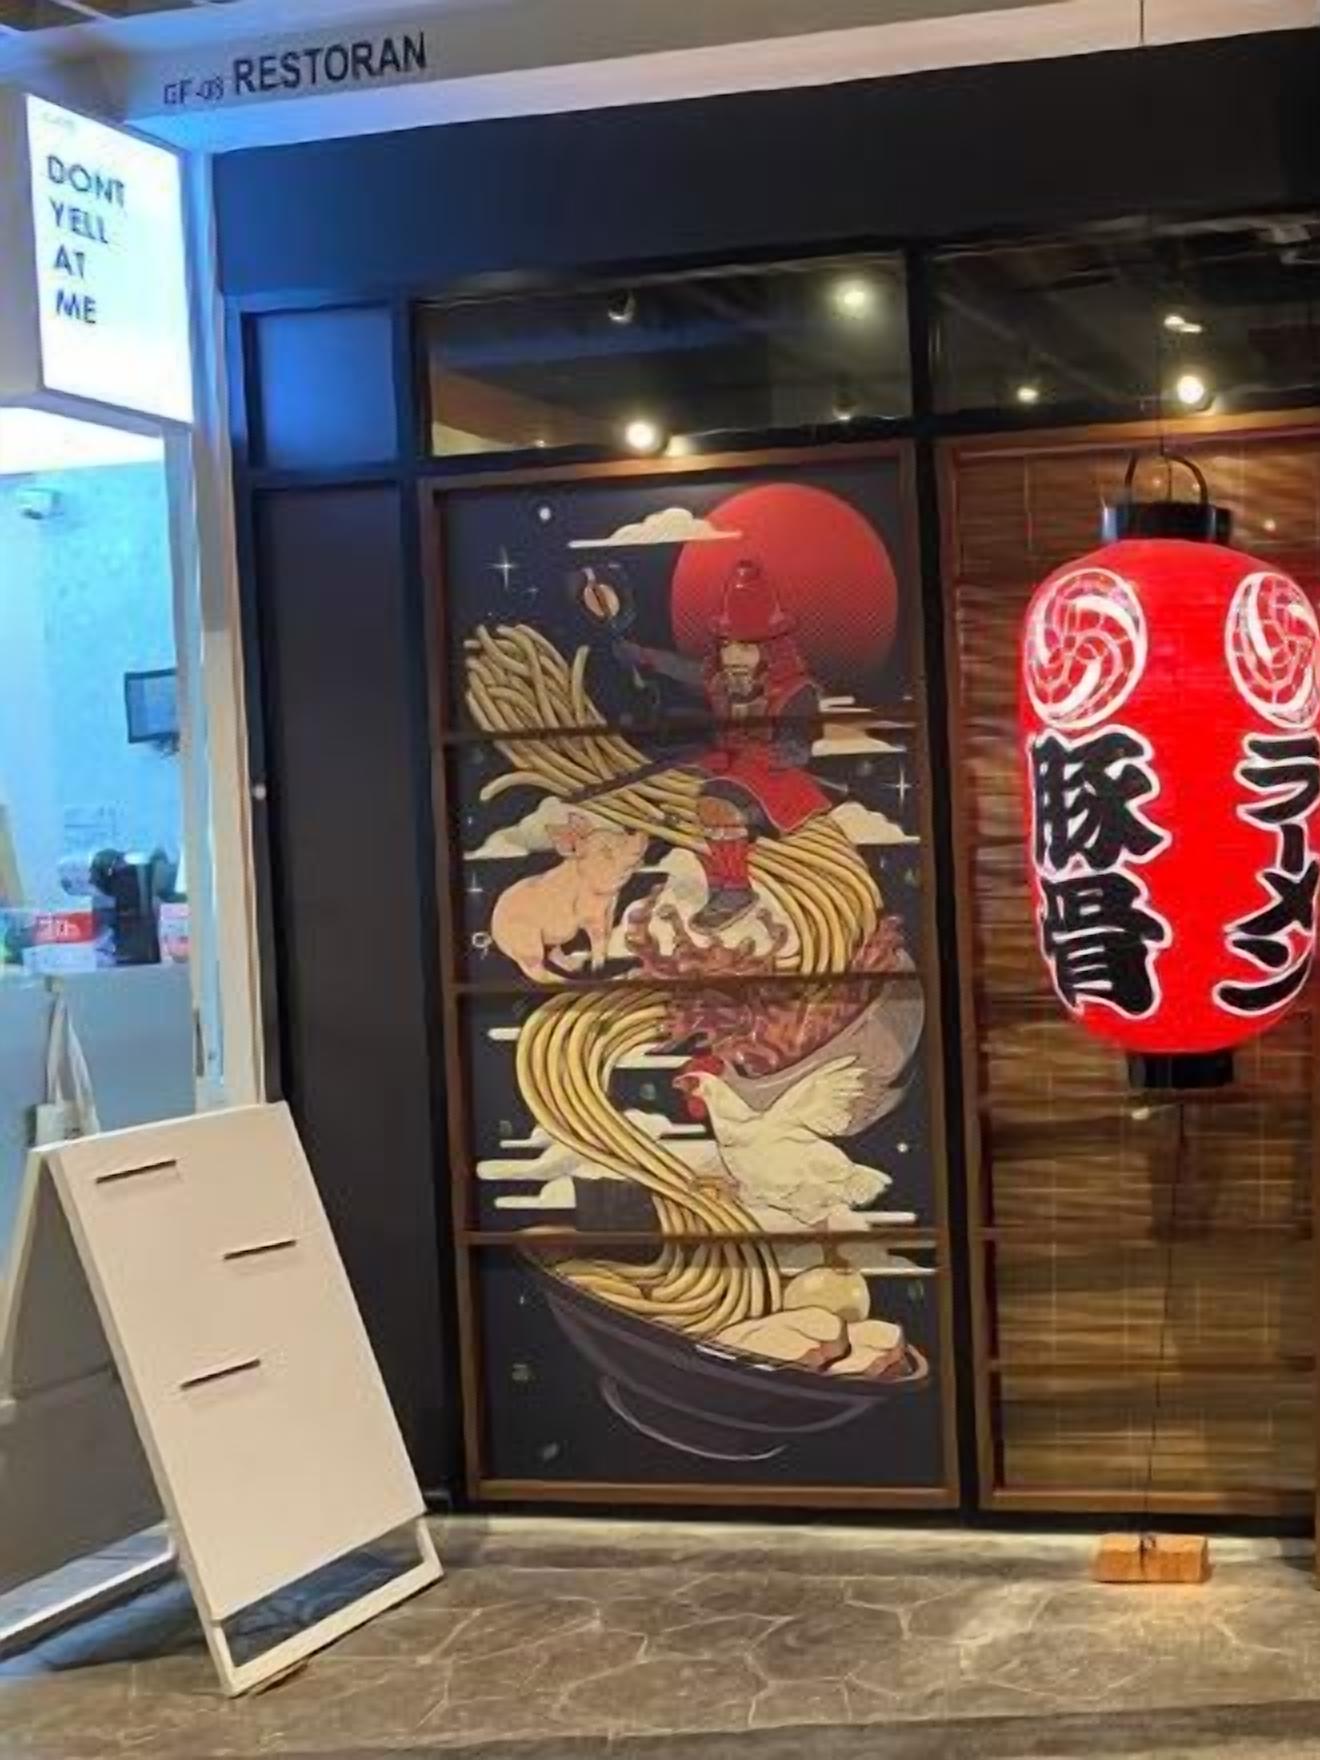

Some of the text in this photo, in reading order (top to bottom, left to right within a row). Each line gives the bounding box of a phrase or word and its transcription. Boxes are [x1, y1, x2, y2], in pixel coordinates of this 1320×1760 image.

[232, 31, 427, 96] RESTORAN
[47, 154, 125, 208] DONT
[49, 196, 109, 245] YELL
[53, 244, 86, 280] AT
[56, 288, 97, 325] ME
[1029, 725, 1171, 1018] 豚骨
